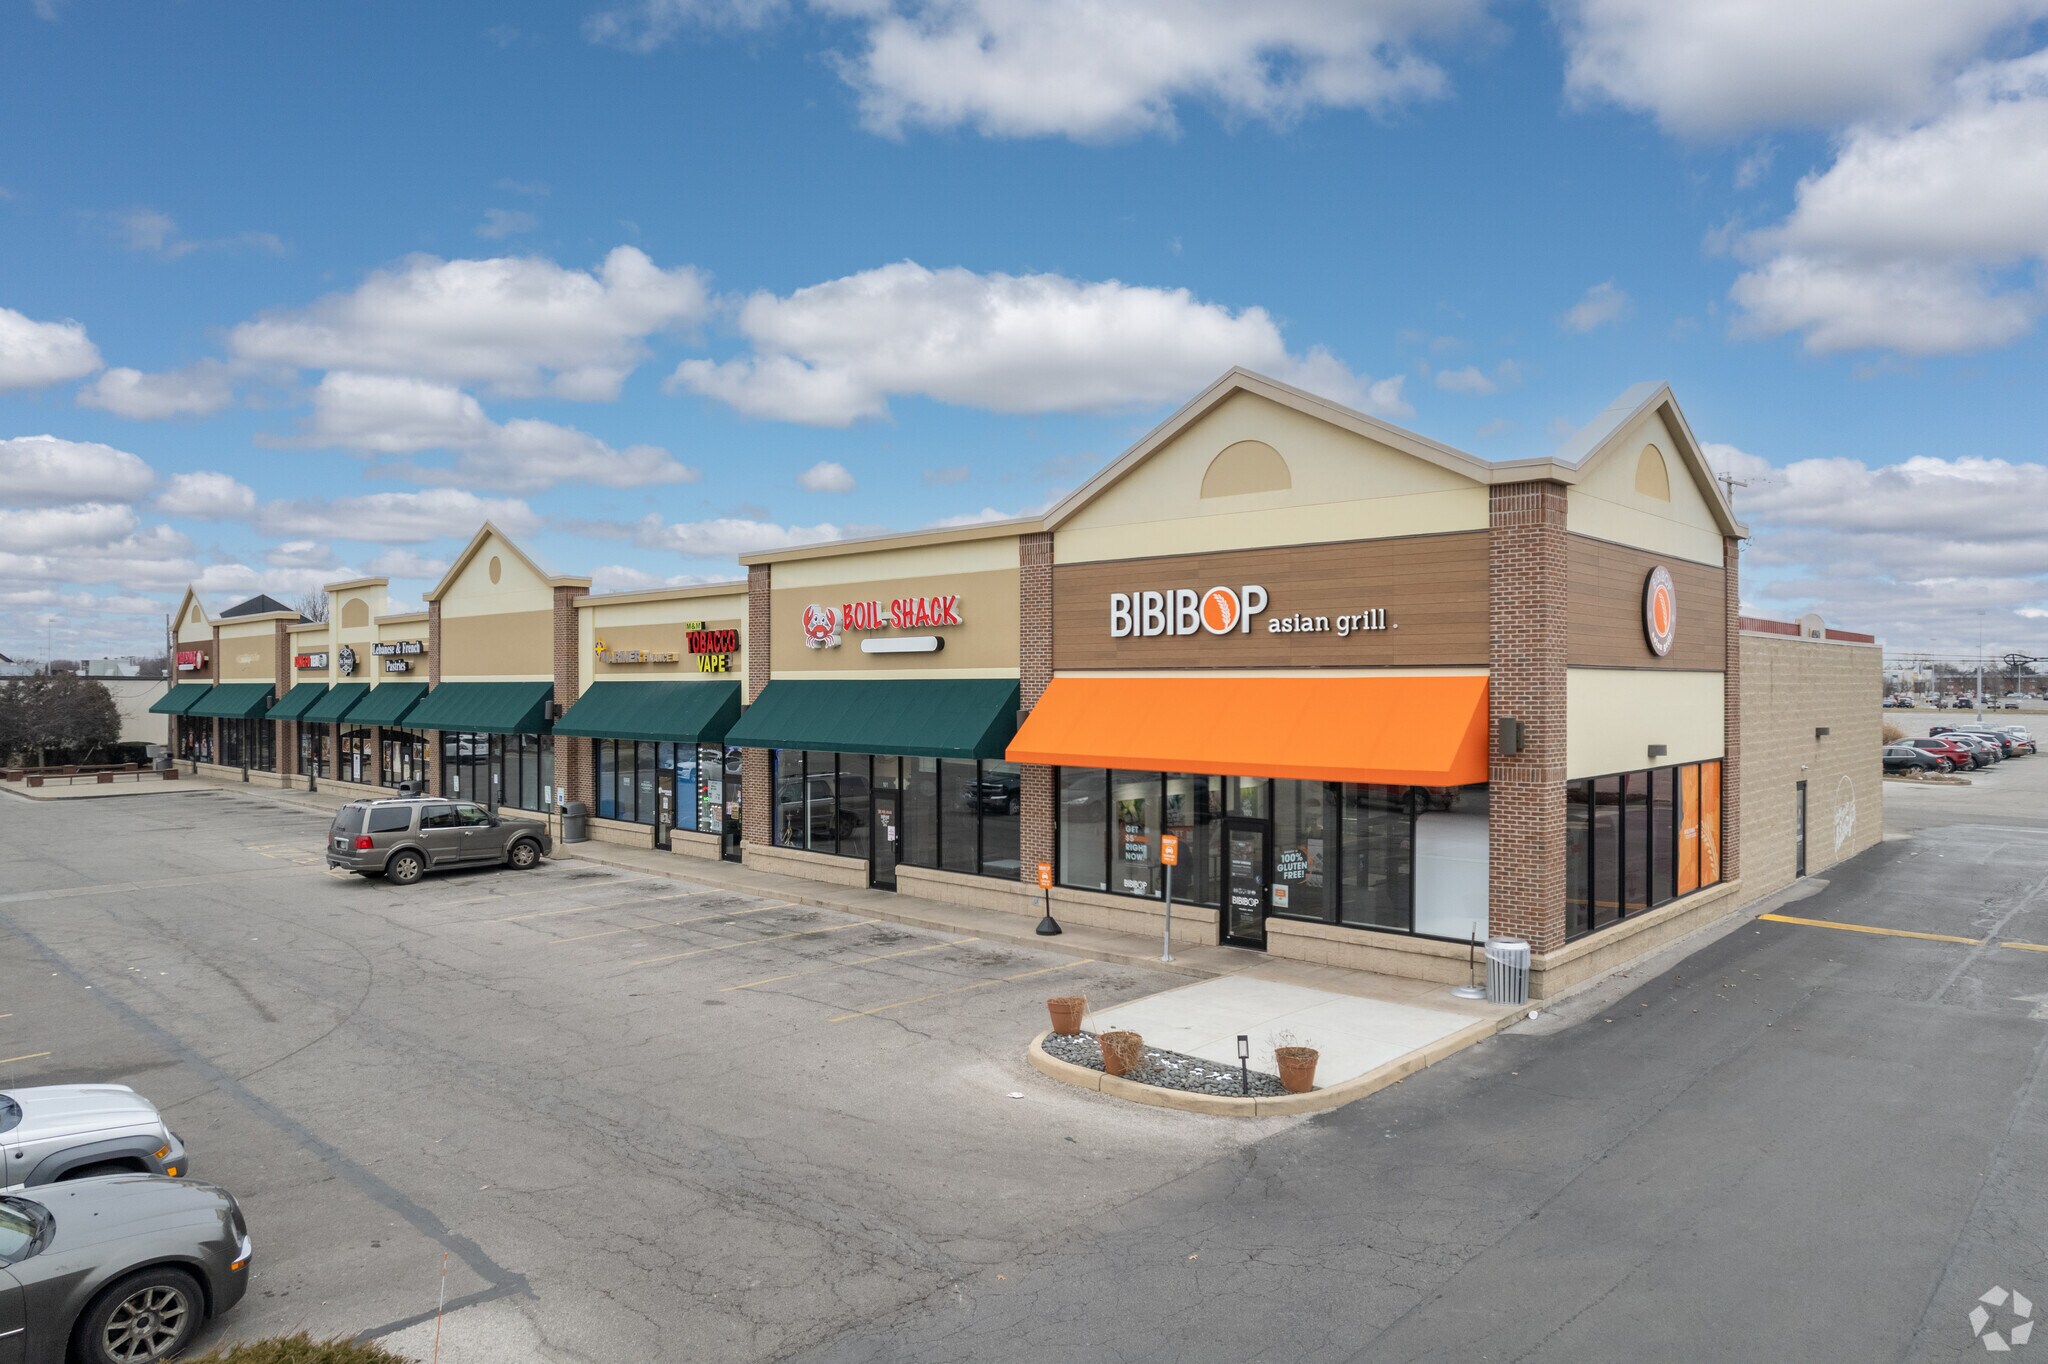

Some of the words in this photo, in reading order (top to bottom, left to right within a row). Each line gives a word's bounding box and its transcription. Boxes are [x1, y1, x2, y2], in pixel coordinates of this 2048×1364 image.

[842, 600, 884, 631] BOIL
[890, 595, 962, 628] SHACK
[1111, 585, 1269, 638] BIBIBOP
[1269, 614, 1330, 634] asian
[1337, 608, 1387, 637] grill
[686, 622, 702, 630] M&M
[685, 629, 736, 654] TOBACCO
[372, 643, 395, 655] Lebanese
[396, 642, 401, 654] &
[402, 641, 420, 653] French
[600, 650, 641, 663] MARINER
[644, 652, 672, 662] FINANCE
[386, 660, 406, 672] Pastries
[697, 654, 726, 672] VAPE
[1125, 825, 1139, 833] GET
[1280, 852, 1304, 864] 100%
[1277, 861, 1308, 872] GLUTEN
[1283, 870, 1305, 880] FREE!
[1124, 879, 1148, 889] BIBIBOP
[1231, 896, 1259, 907] BIBIBOP
